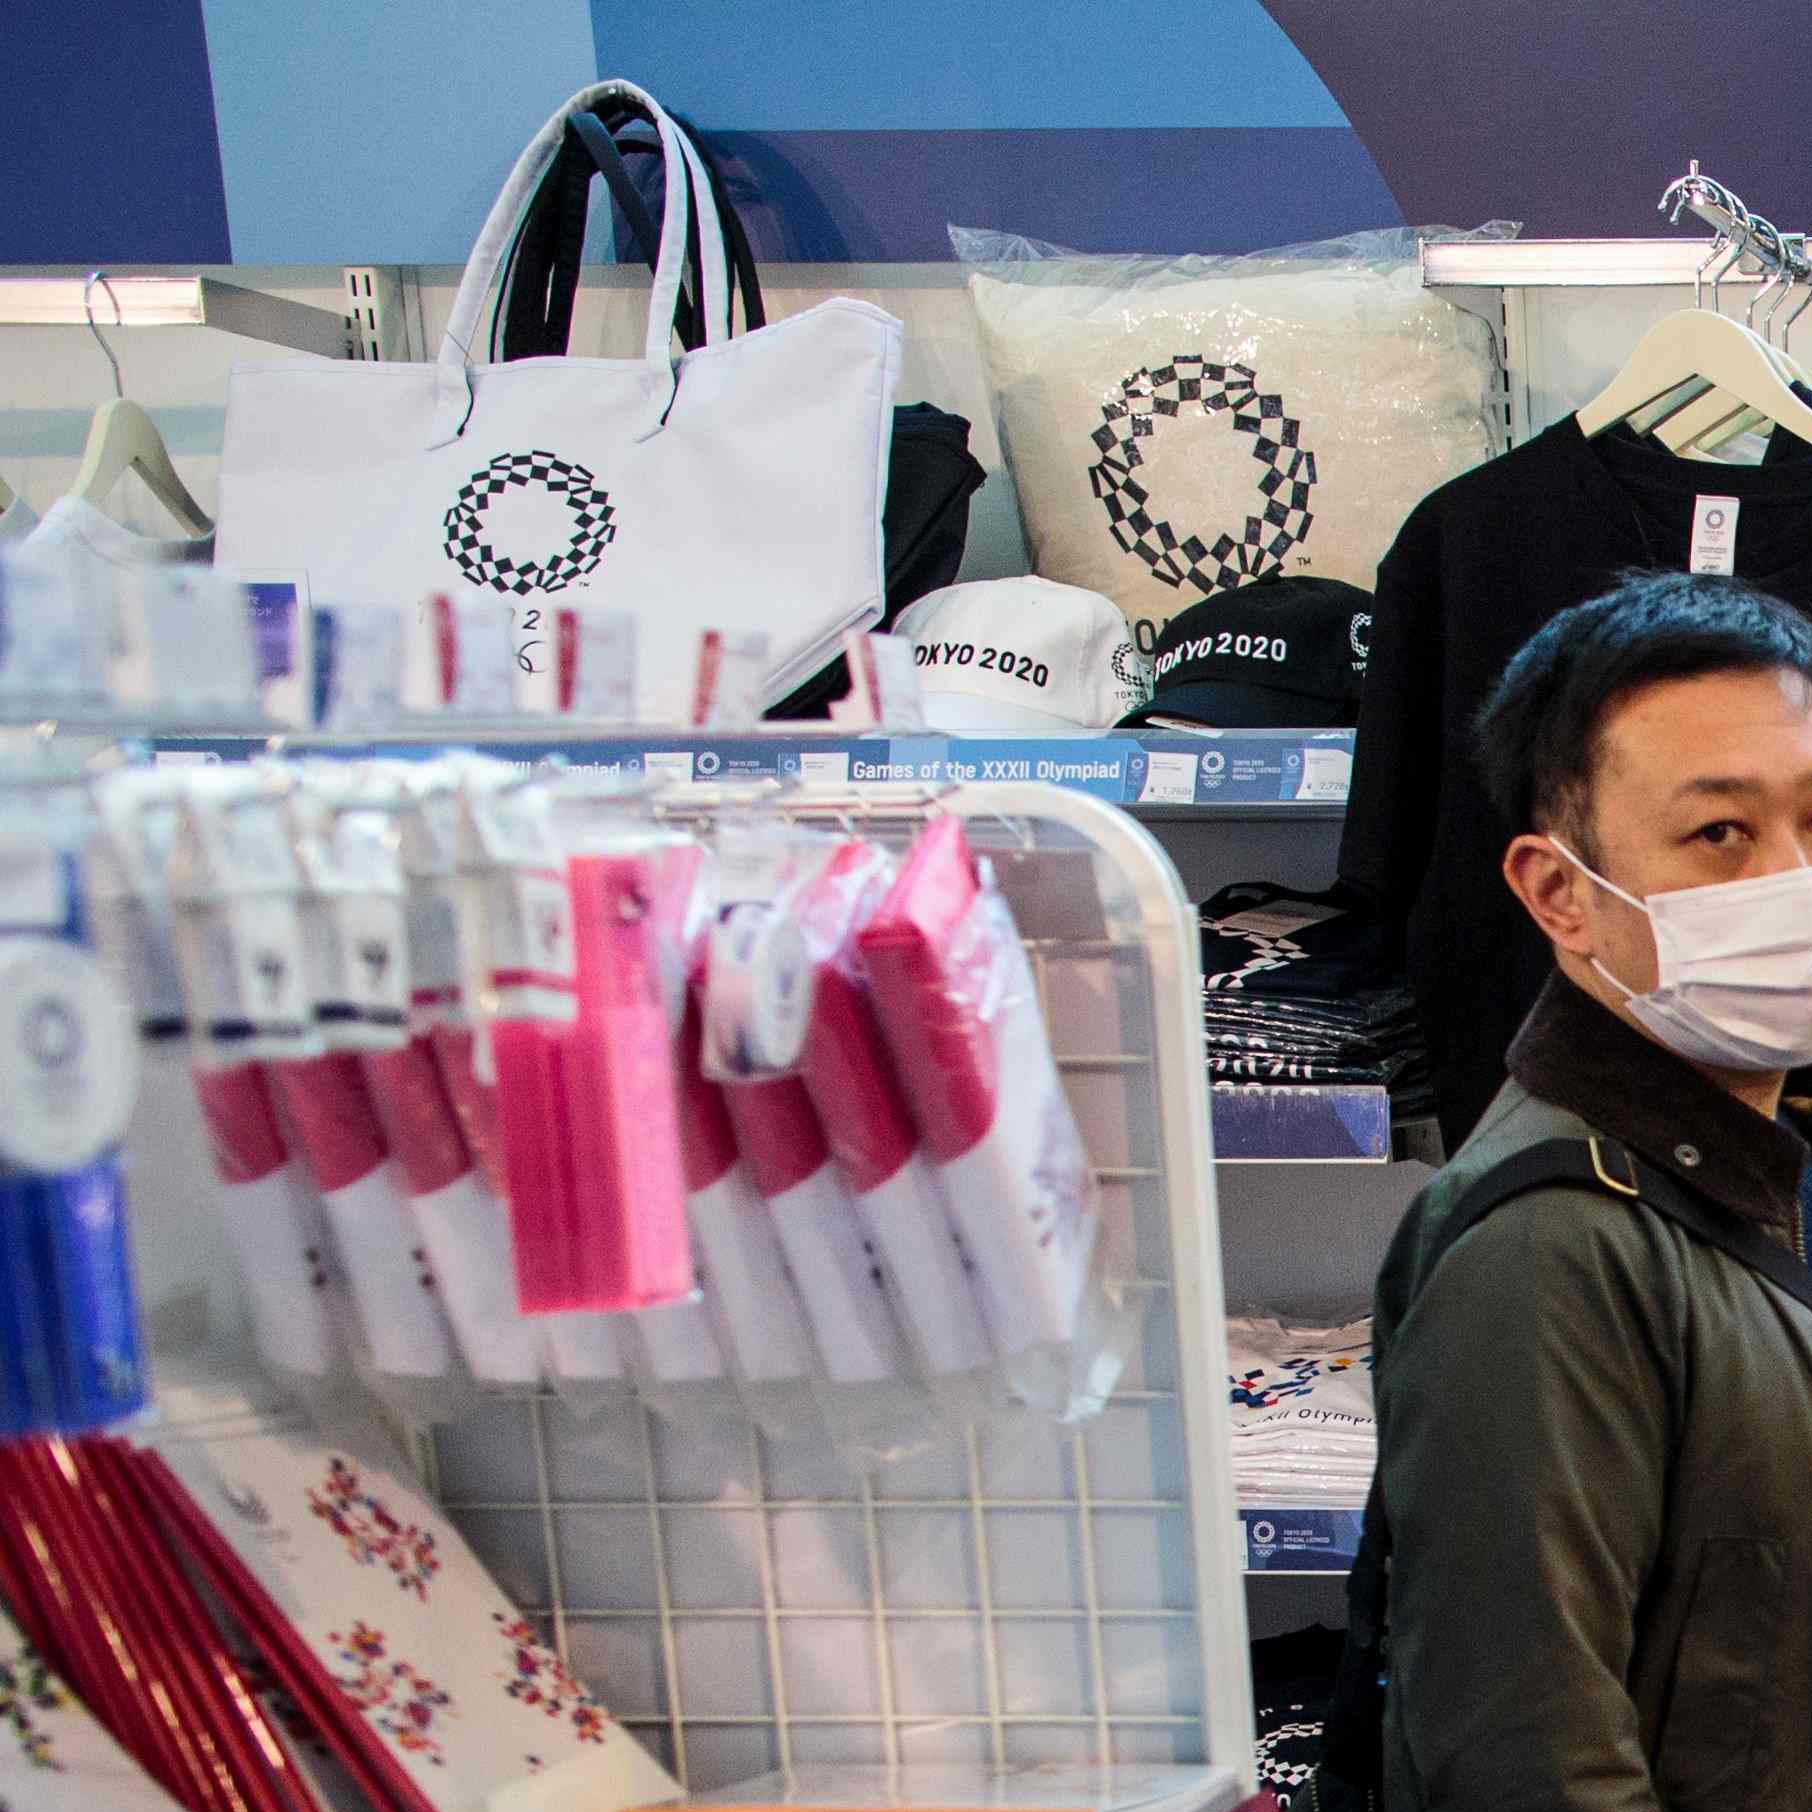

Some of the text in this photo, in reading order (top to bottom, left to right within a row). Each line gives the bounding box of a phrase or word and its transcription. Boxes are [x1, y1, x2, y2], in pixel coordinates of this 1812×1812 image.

[1214, 631, 1287, 663] 2020
[914, 642, 1049, 688] OKYO 2020
[853, 760, 1120, 783] Games of the XXXII Olympiad
